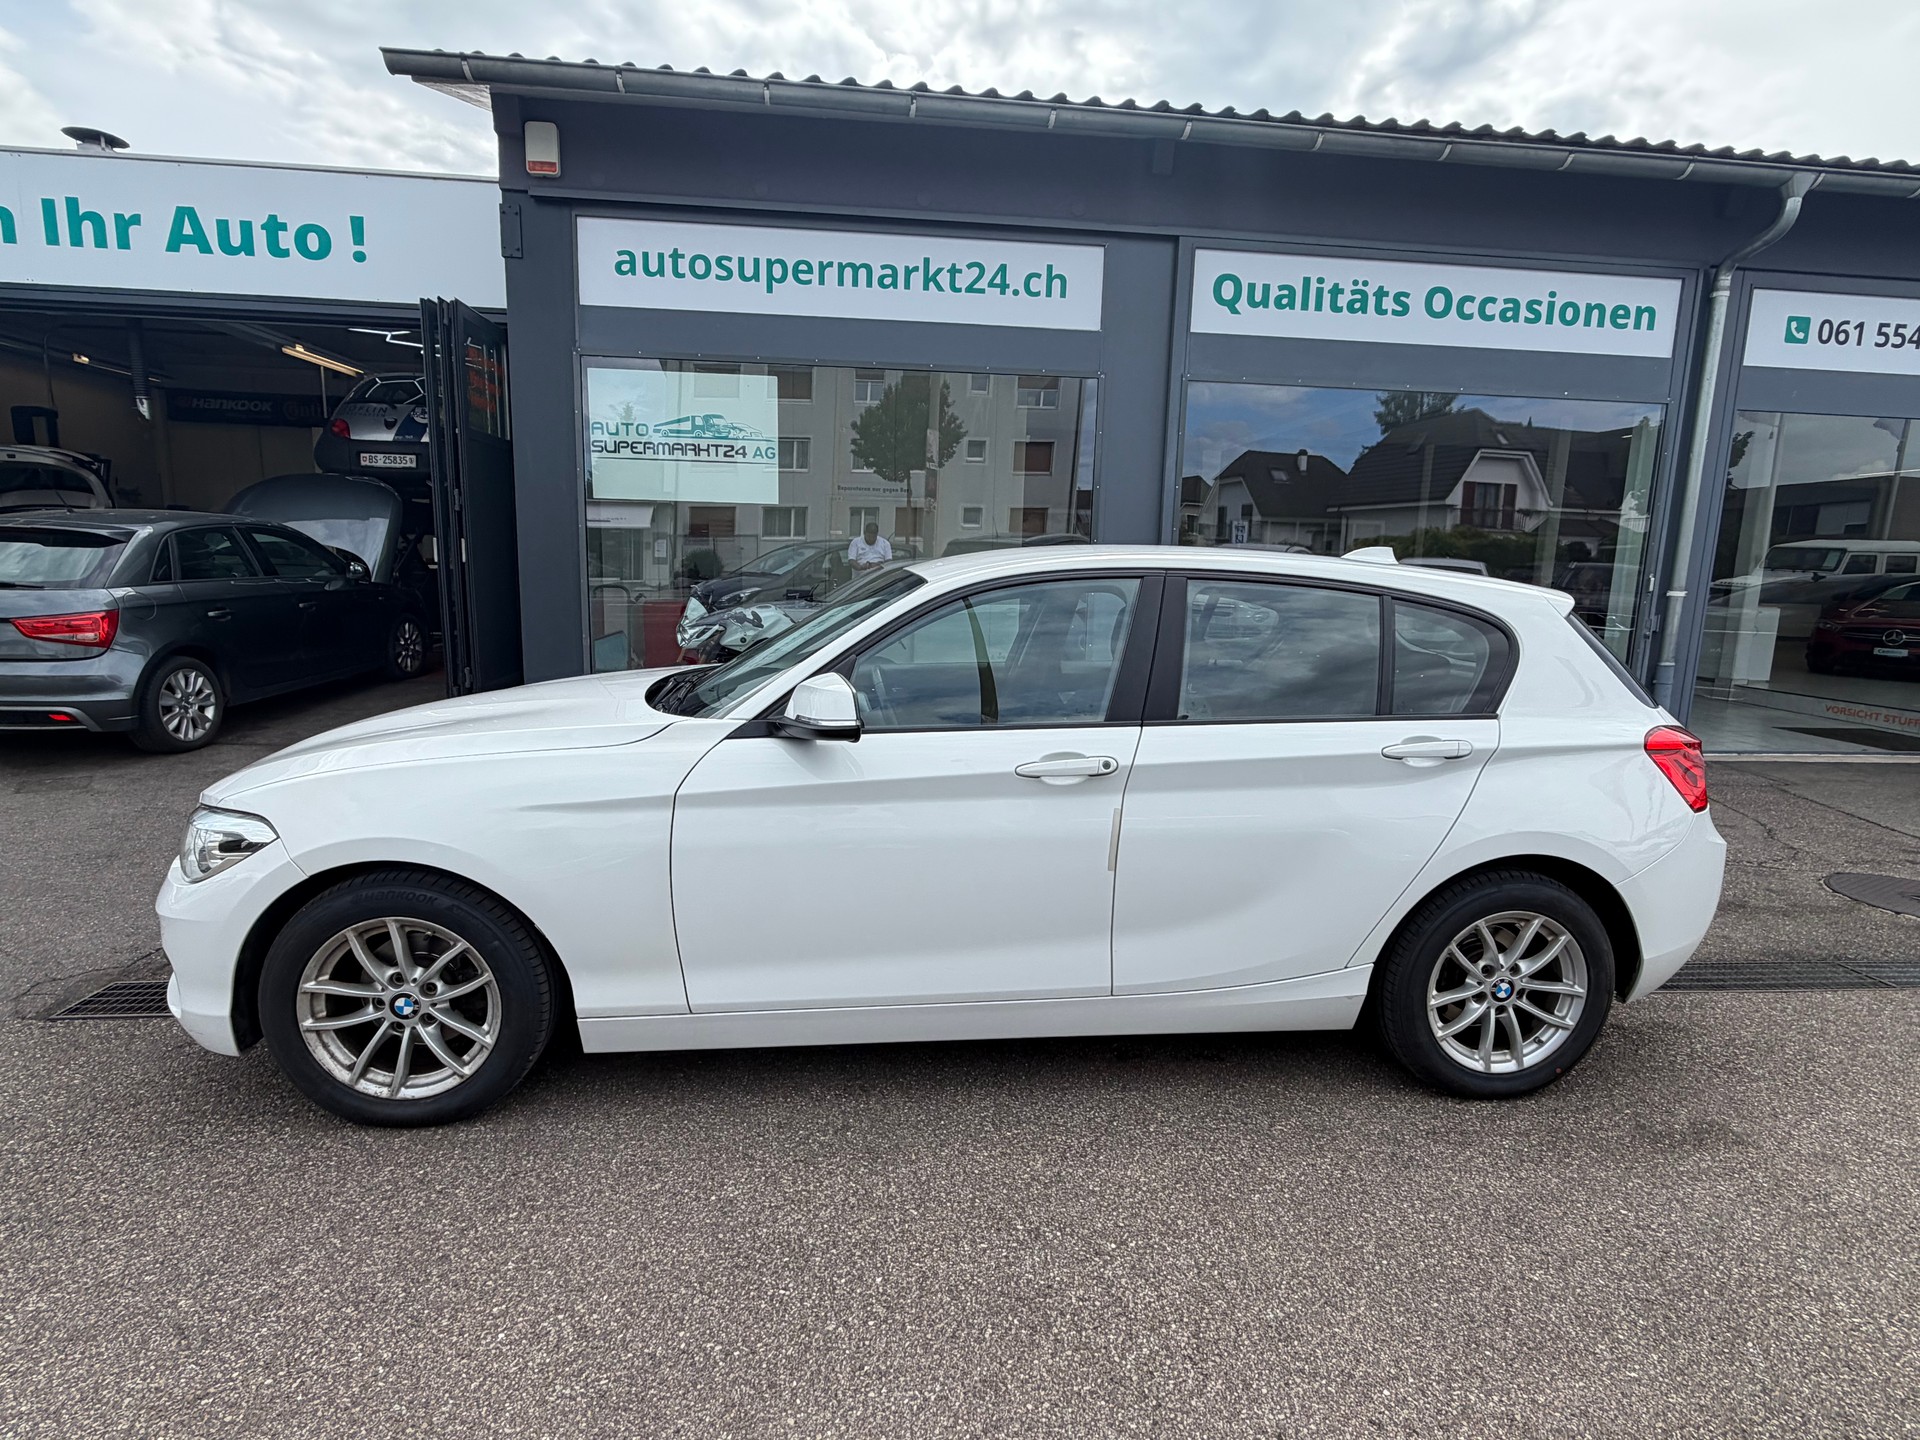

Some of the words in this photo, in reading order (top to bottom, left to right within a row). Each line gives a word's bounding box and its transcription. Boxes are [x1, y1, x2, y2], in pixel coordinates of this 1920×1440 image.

[39, 195, 142, 251] Ihr
[613, 247, 1068, 299] autosupermarkt24.ch
[1211, 273, 1411, 317] Qualitäts
[1424, 286, 1657, 331] Occasionen
[1817, 318, 1865, 347] 061
[1874, 322, 1920, 350] 554
[591, 421, 649, 437] AUTO
[591, 440, 748, 459] SUPERMARKT24
[752, 446, 776, 460] AG
[1825, 704, 1881, 721] VORSICHT
